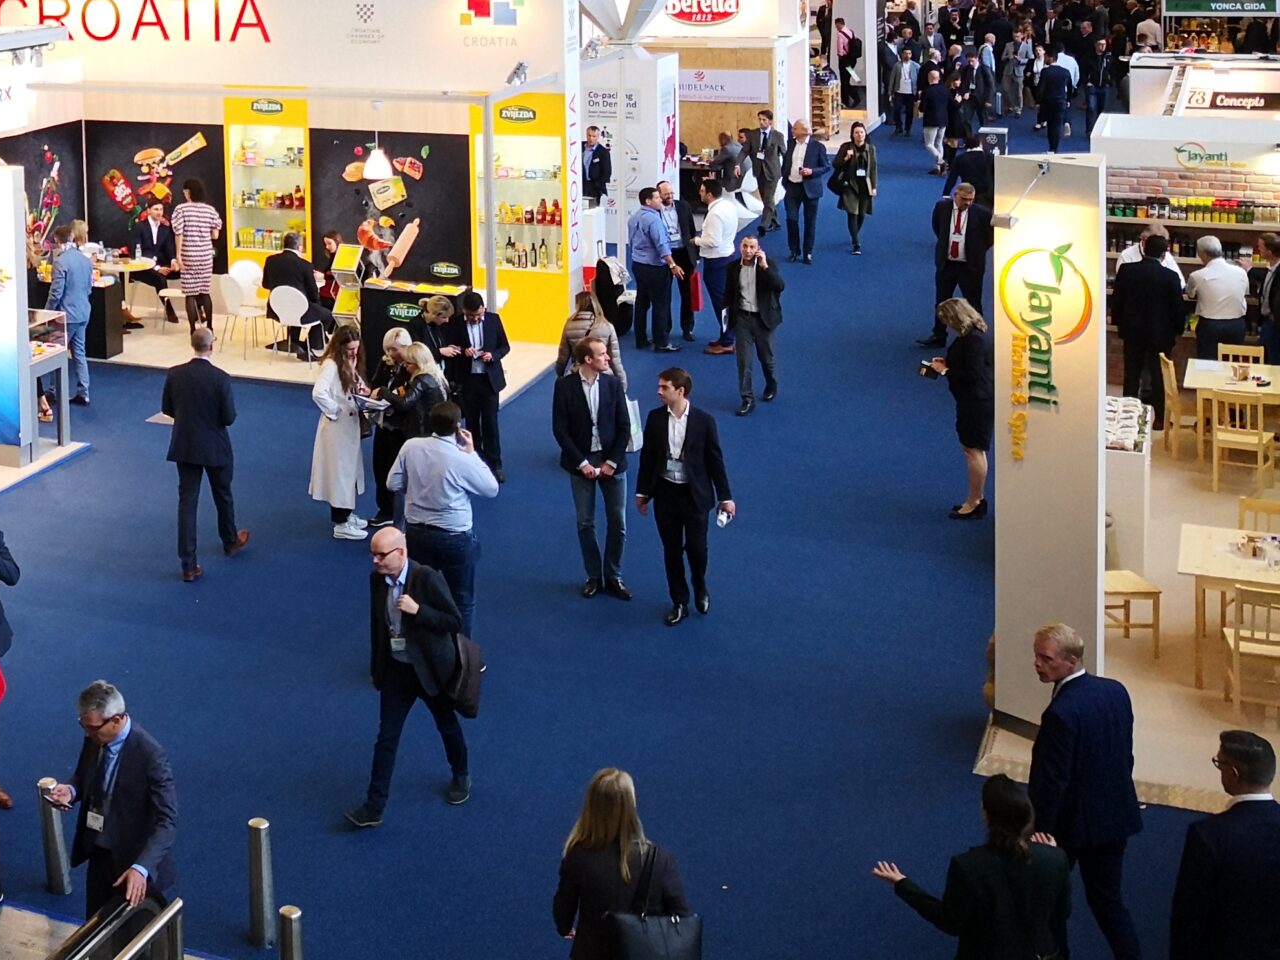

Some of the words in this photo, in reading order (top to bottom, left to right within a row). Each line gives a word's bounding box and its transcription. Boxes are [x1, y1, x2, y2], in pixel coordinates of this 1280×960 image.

[691, 14, 712, 22] 1812
[463, 36, 518, 47] CROATIA
[1187, 90, 1206, 105] 73
[1216, 95, 1265, 109] Concepts
[1187, 150, 1227, 163] Jayanti
[569, 93, 580, 252] CROATIA
[389, 308, 422, 317] ZVIJEZD
[1020, 277, 1061, 407] Jayanti
